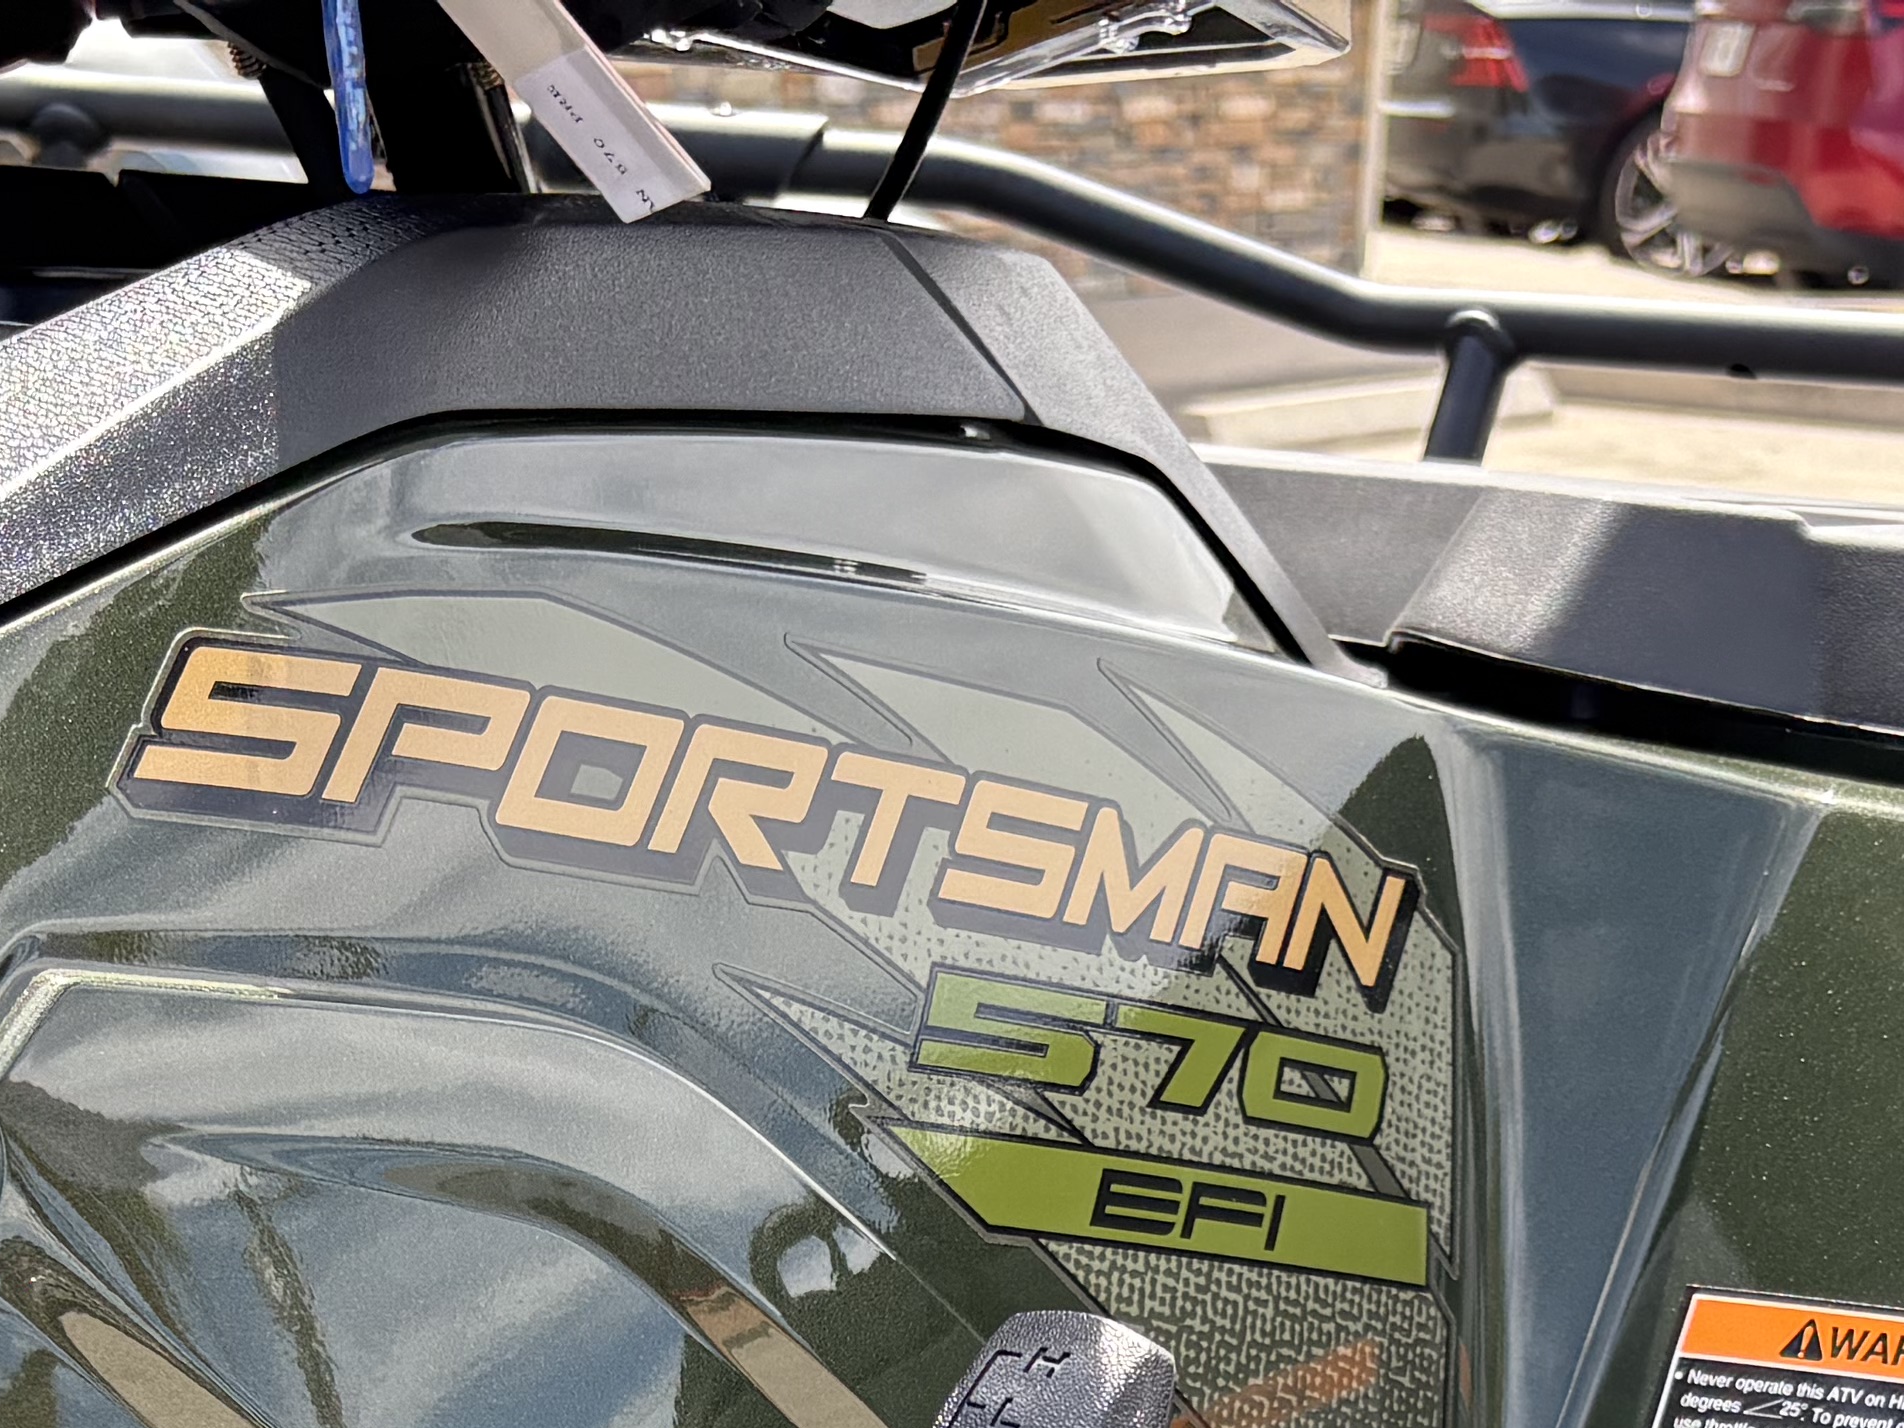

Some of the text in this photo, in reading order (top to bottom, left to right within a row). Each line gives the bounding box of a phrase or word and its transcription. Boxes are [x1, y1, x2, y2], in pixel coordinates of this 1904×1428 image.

[136, 644, 1414, 988] SPORTSMAN
[913, 970, 1388, 1140] 570
[1089, 1173, 1285, 1252] EFI
[1024, 1347, 1071, 1378] H
[1679, 1391, 1741, 1413] degrees
[1811, 1406, 1832, 1424] To
[1686, 1368, 1734, 1388] Never
[1734, 1377, 1794, 1396] operate
[1795, 1381, 1824, 1400] this
[1825, 1385, 1864, 1404] ATV
[1863, 1393, 1886, 1408] on
[990, 1397, 1021, 1428] L
